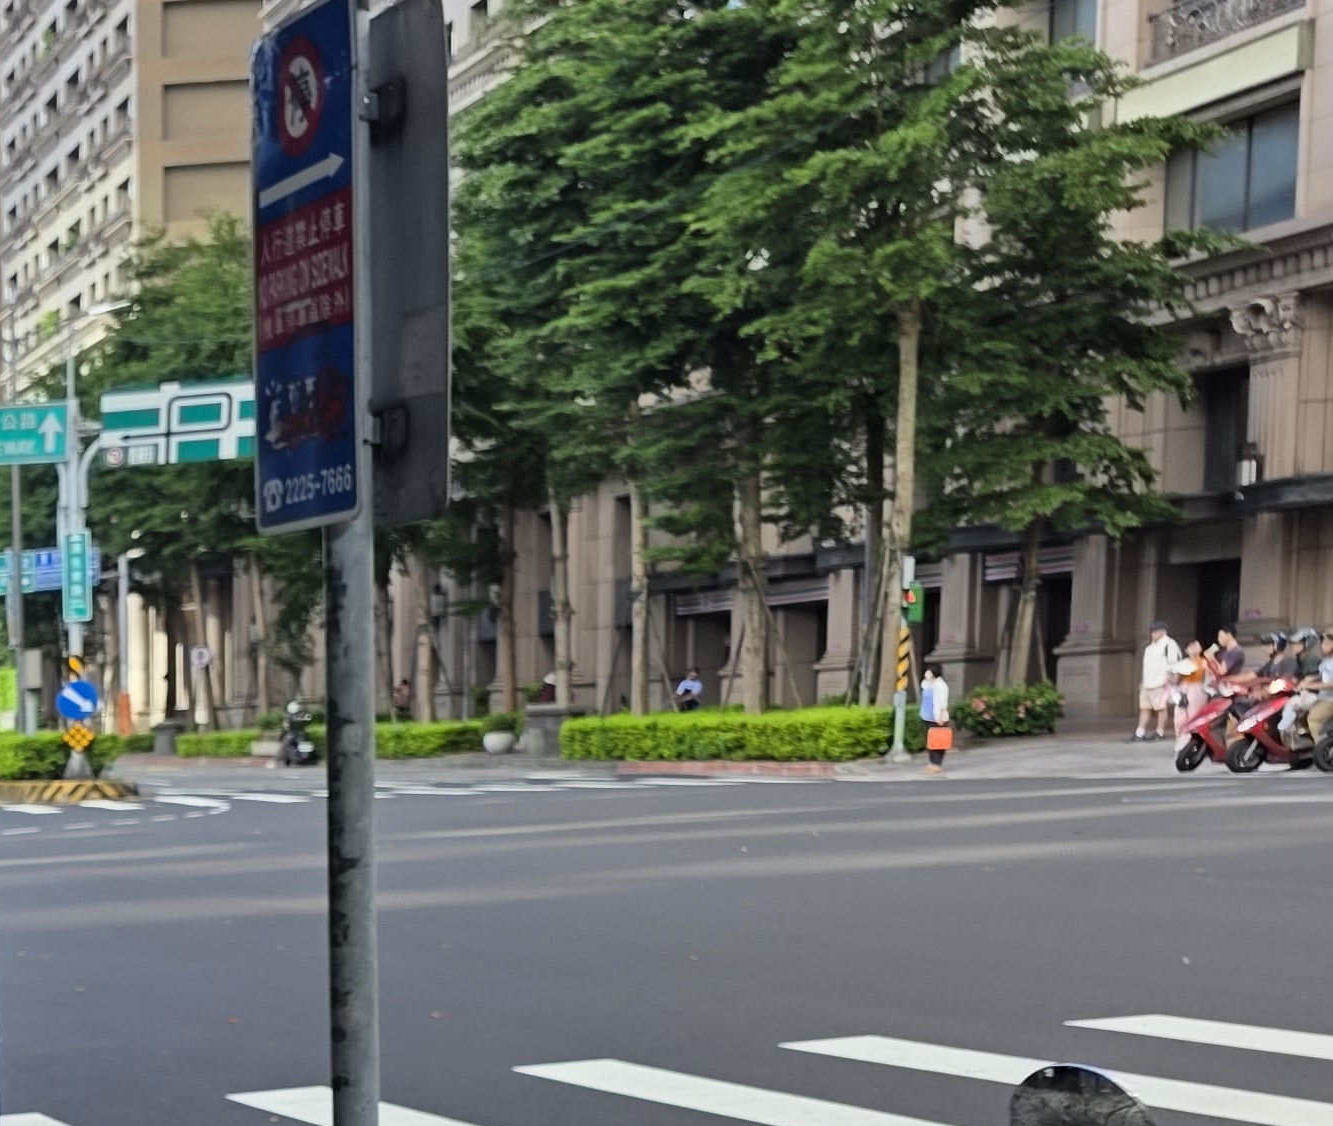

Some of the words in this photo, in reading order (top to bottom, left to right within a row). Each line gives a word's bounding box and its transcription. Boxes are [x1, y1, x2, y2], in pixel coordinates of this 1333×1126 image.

[259, 200, 346, 267] 人行道禁止停車
[285, 463, 353, 505] 2225-7666
